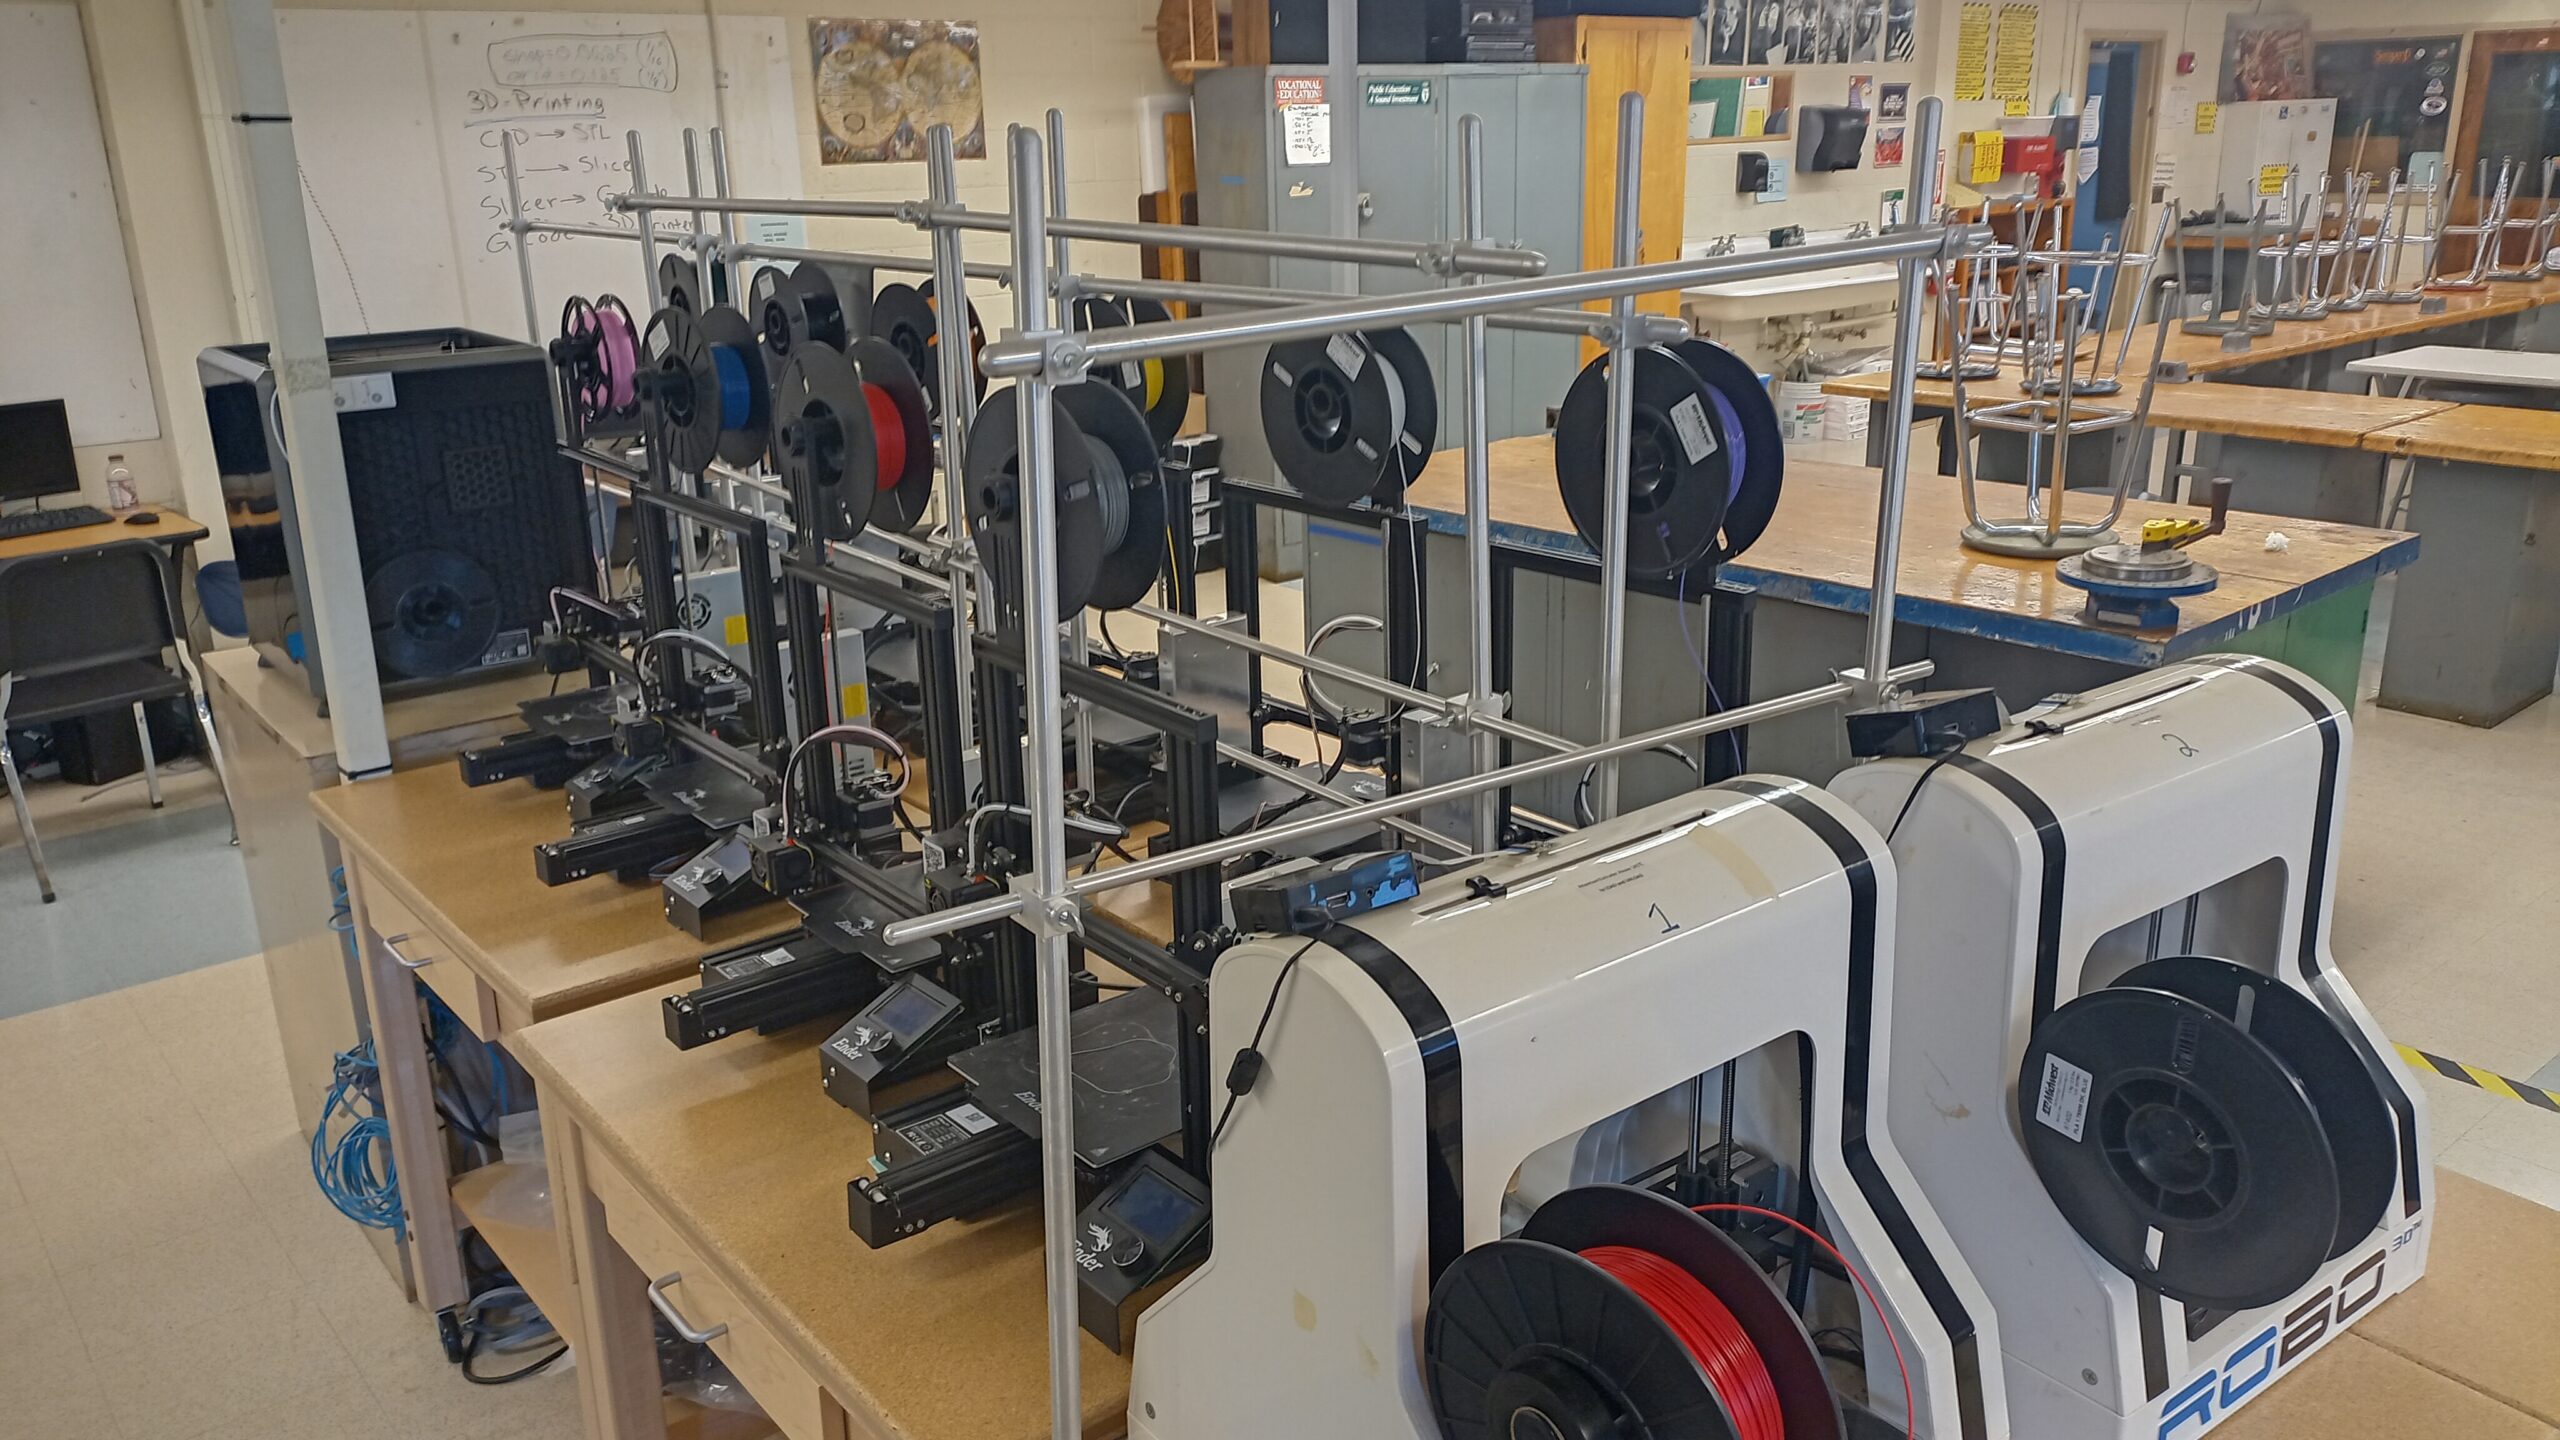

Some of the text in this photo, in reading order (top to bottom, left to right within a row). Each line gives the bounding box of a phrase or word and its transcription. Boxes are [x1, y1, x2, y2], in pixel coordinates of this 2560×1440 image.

[480, 123, 611, 148] CD STL
[480, 195, 560, 220] Slcer
[1648, 902, 1680, 935] 1
[831, 1037, 863, 1060] Ender
[1075, 1239, 1105, 1271] nder
[2158, 1248, 2387, 1440] ROBO
